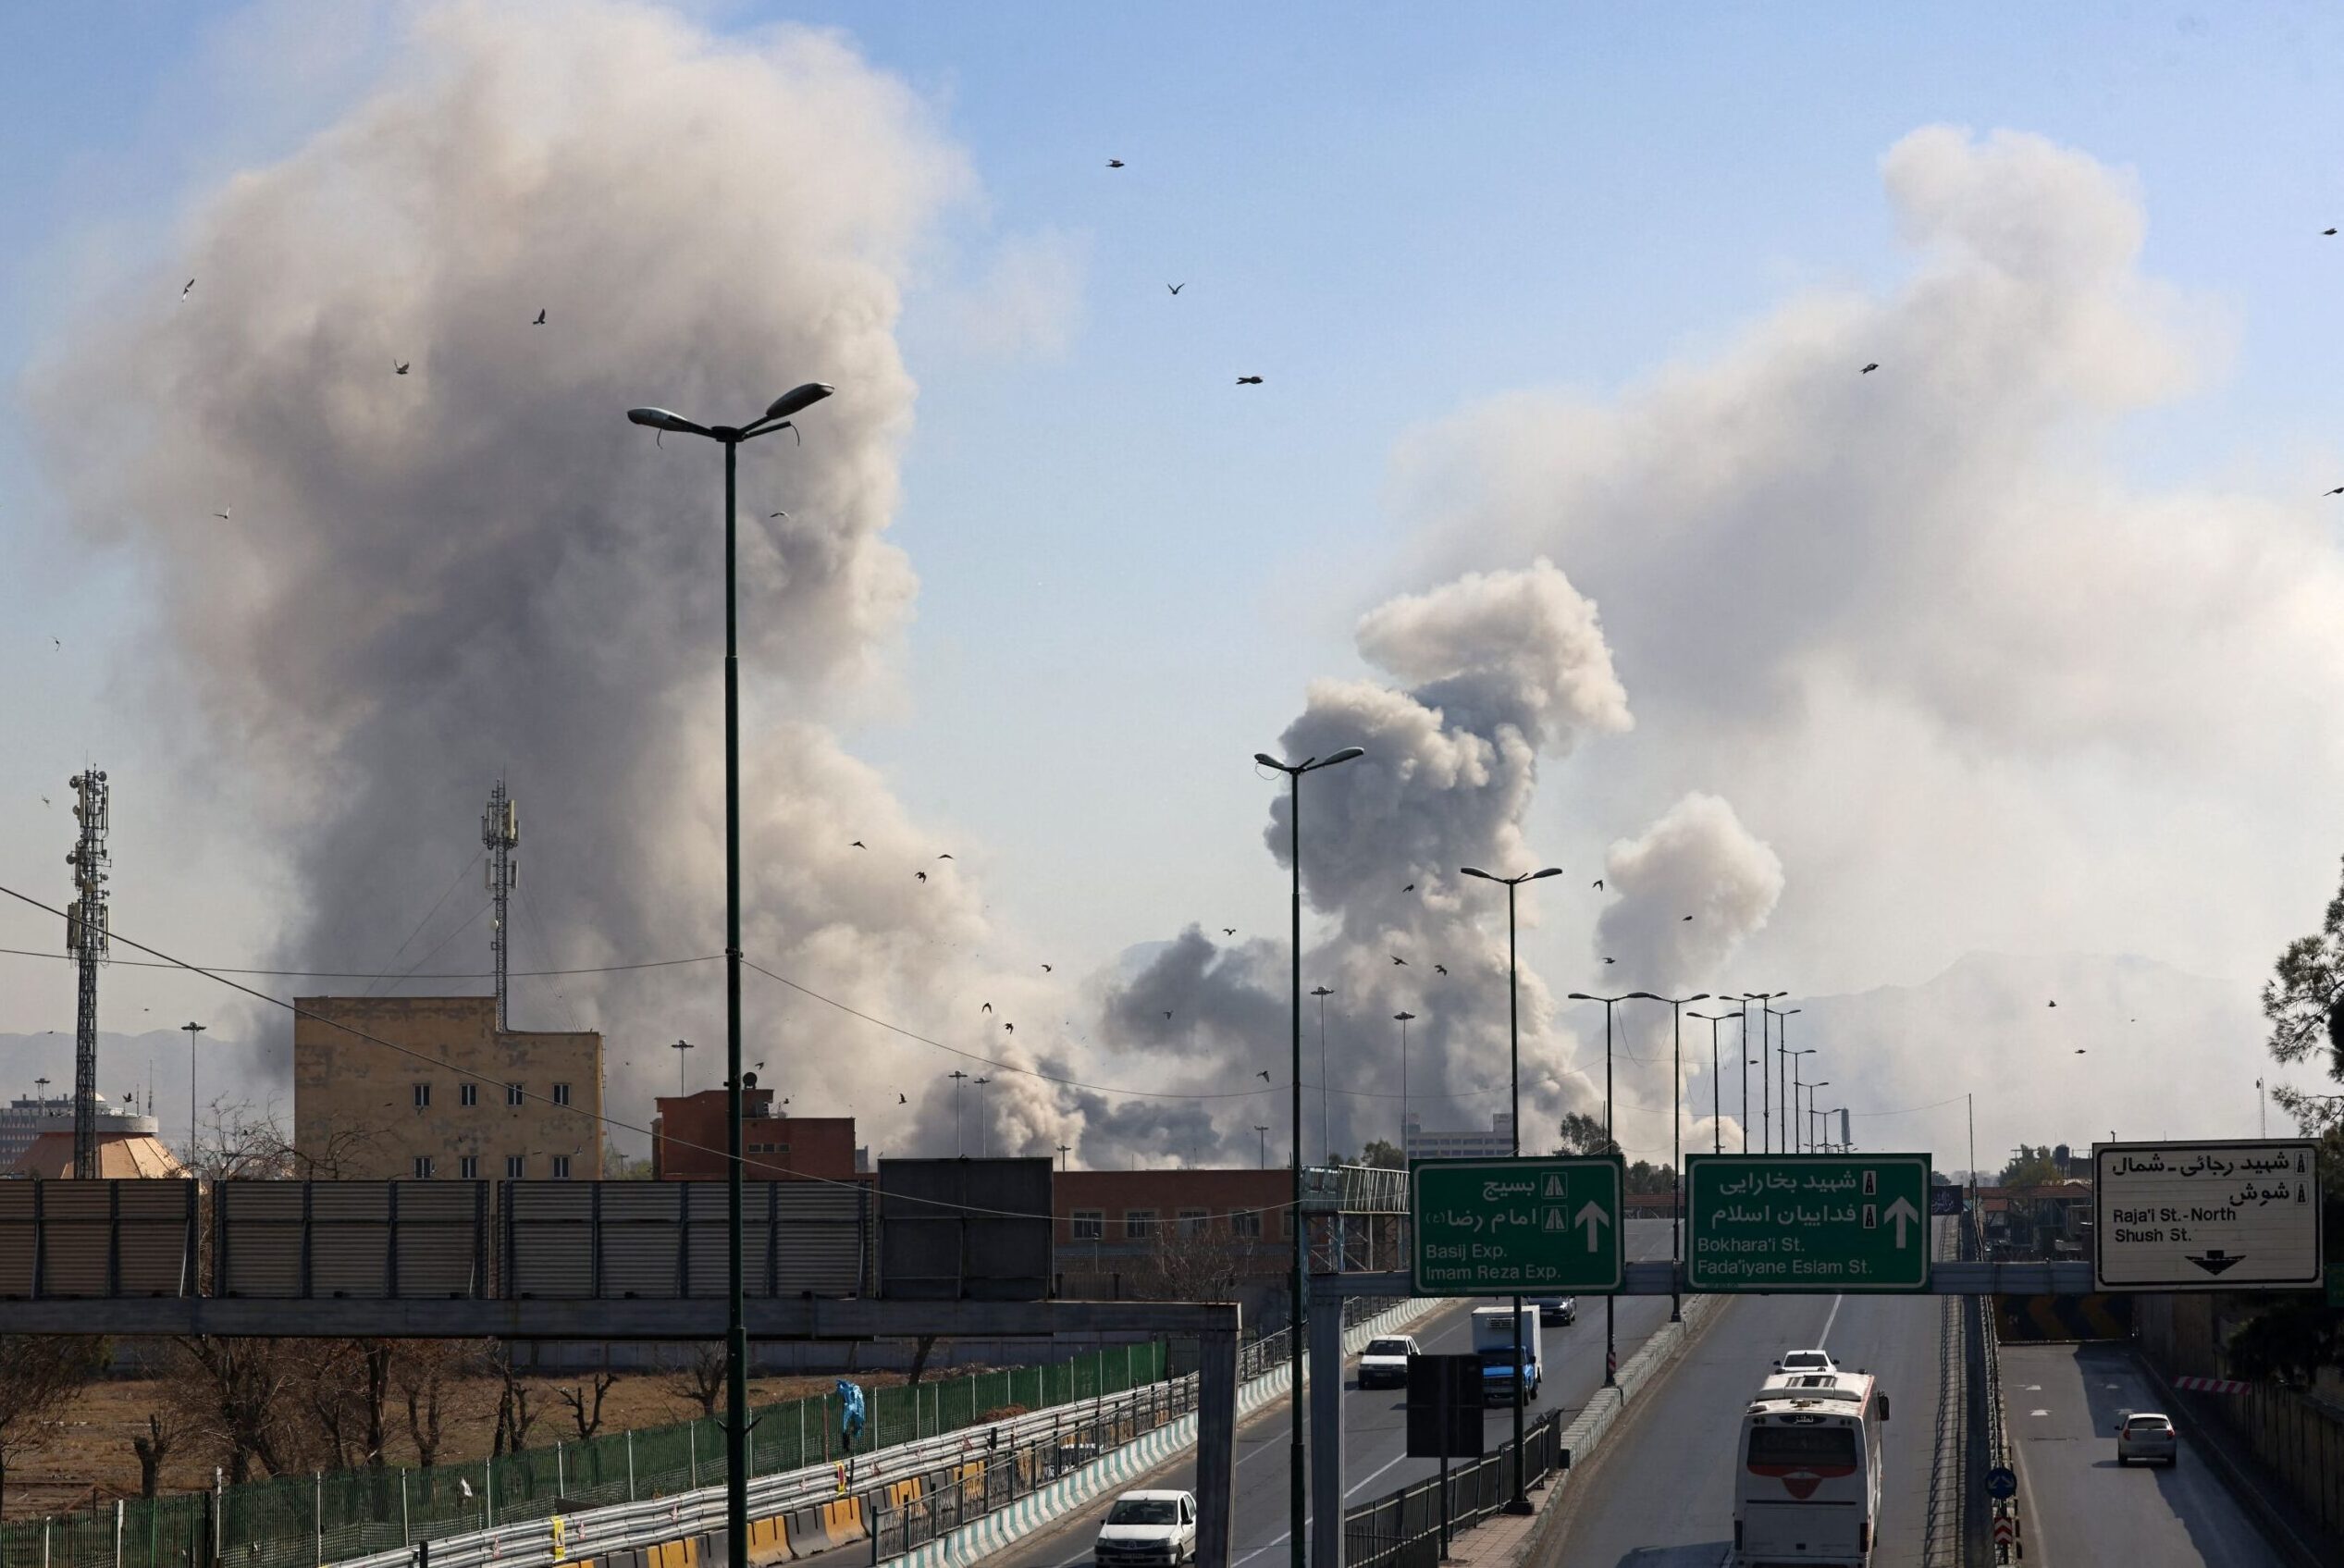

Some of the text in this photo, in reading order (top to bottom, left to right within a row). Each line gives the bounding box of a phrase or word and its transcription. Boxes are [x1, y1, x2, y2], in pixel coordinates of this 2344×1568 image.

[2240, 1152, 2289, 1174] شهید
[1482, 1181, 1536, 1202] بسیج
[1719, 1170, 1857, 1196] شهید بخارایی
[2229, 1182, 2289, 1206] شوش
[1491, 1208, 1536, 1233] امام
[1711, 1204, 1857, 1229] فداییان اسلام
[2113, 1208, 2154, 1225] Raja'i
[1697, 1237, 1806, 1252] Bokhara'i St.
[2115, 1228, 2191, 1242] Shush St.
[1425, 1243, 1508, 1261] Basij Exp.
[1426, 1264, 1561, 1281] Imam Reza Exp.
[1697, 1259, 1872, 1277] Fada'iyane Eslam St.
